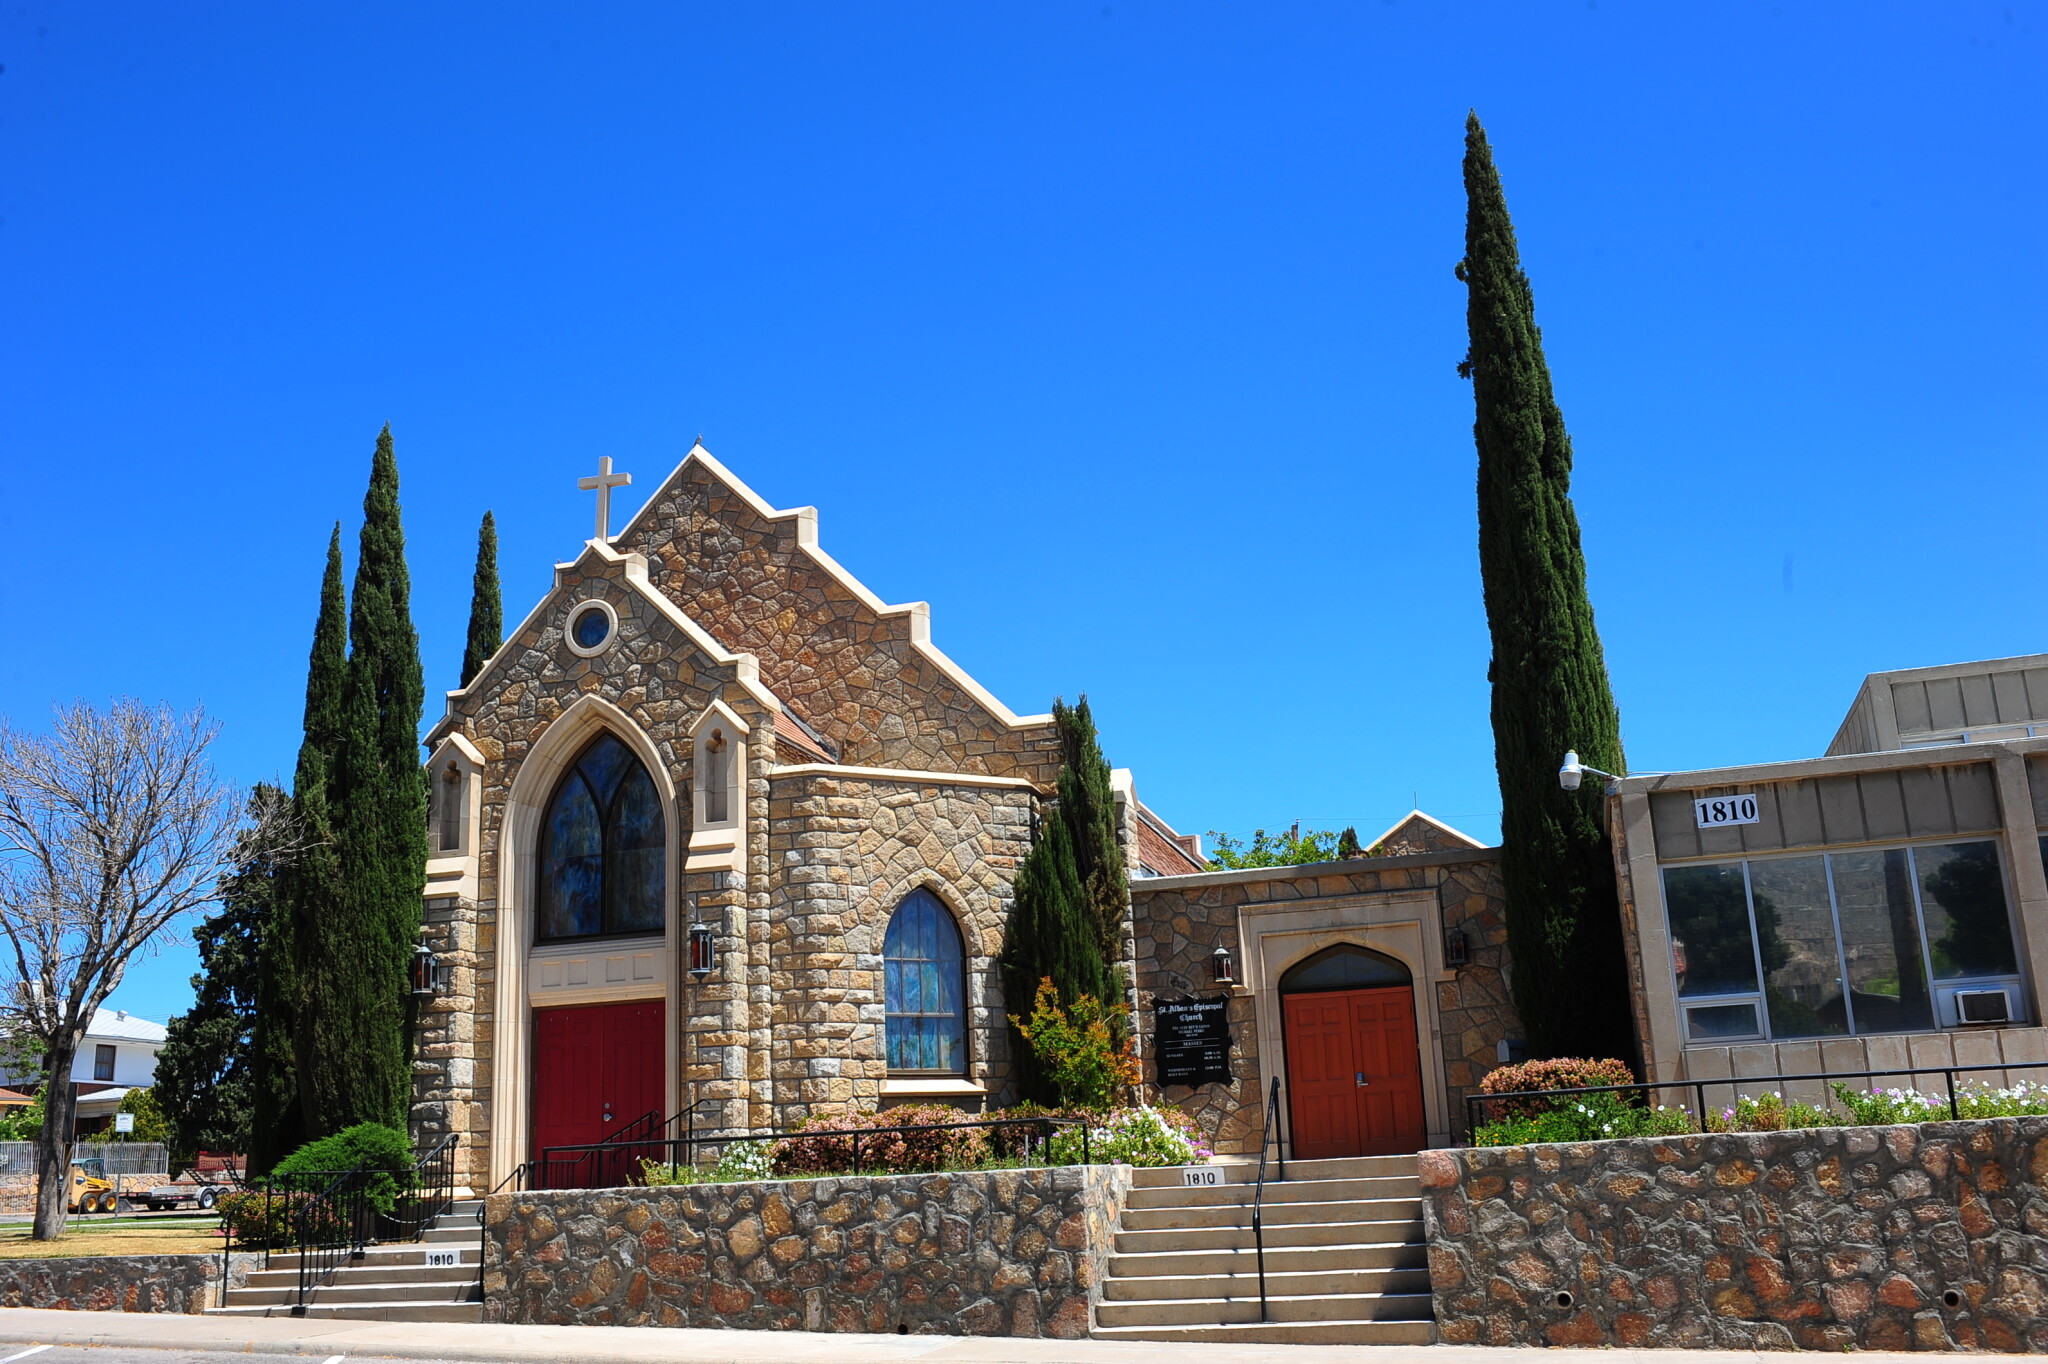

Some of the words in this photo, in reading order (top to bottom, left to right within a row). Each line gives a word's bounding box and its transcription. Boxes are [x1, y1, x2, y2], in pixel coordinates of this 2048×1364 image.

[1698, 799, 1756, 823] 1810
[1168, 1005, 1193, 1014] Alban's
[1194, 1002, 1223, 1012] Episcopal
[1179, 1013, 1203, 1022] Church
[1186, 1172, 1215, 1186] 1810
[429, 1254, 453, 1265] 1810
